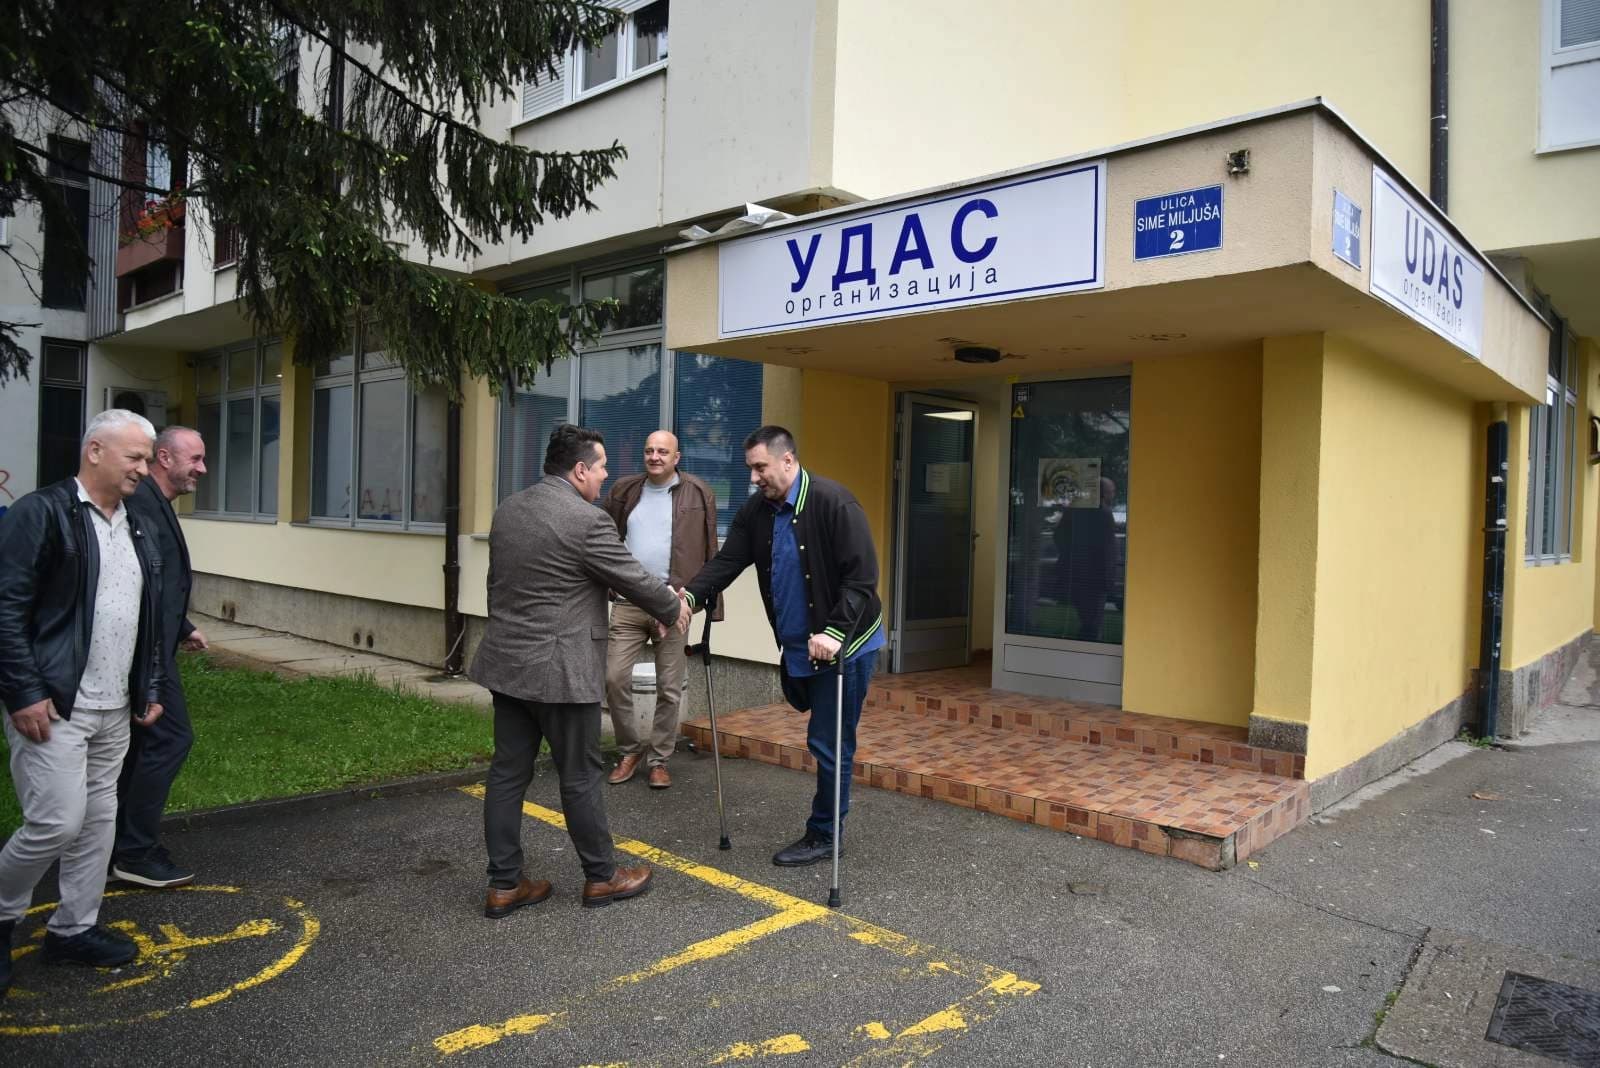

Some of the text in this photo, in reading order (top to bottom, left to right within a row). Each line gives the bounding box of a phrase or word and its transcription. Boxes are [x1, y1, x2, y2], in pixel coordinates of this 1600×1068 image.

[1137, 202, 1221, 232] SIME MILJUŠA
[1160, 195, 1195, 211] ULICA
[786, 198, 999, 293] УДАС
[1169, 229, 1184, 250] 2
[1404, 208, 1464, 310] UDAS
[785, 266, 998, 317] организација
[1403, 277, 1463, 333] organizacija
